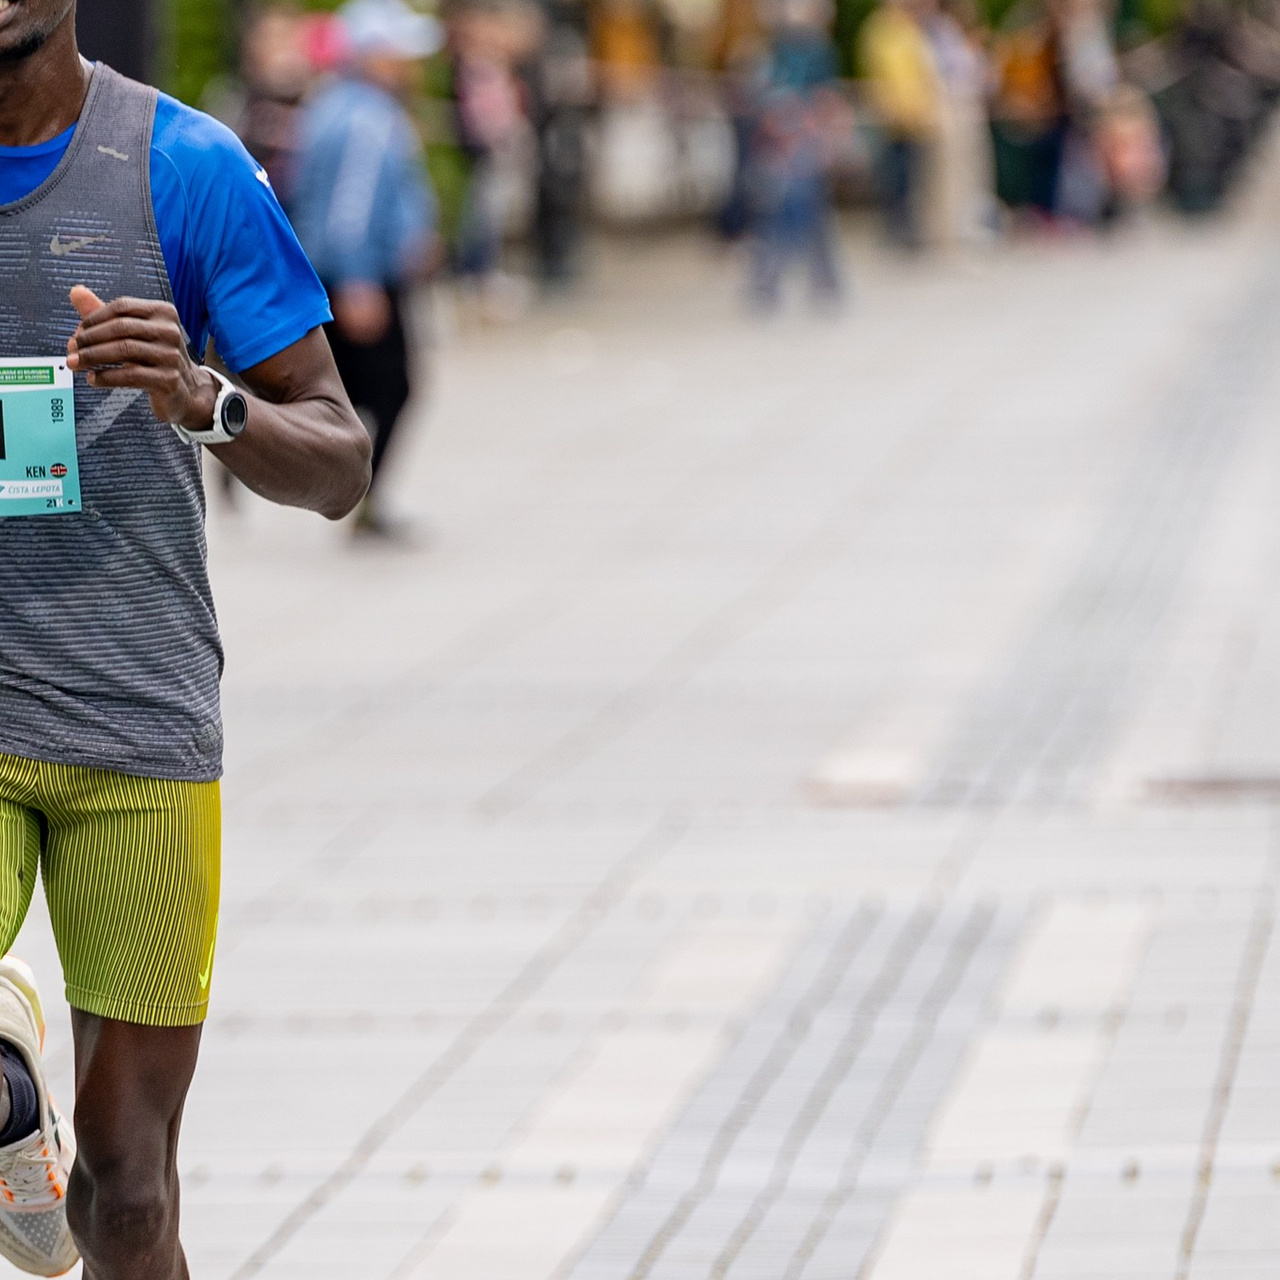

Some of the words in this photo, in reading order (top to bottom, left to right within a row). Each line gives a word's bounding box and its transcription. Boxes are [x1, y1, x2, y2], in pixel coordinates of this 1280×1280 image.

[50, 398, 64, 424] 1989
[26, 466, 46, 478] KEN
[31, 485, 60, 493] LEPOTA
[46, 498, 64, 508] 21K
